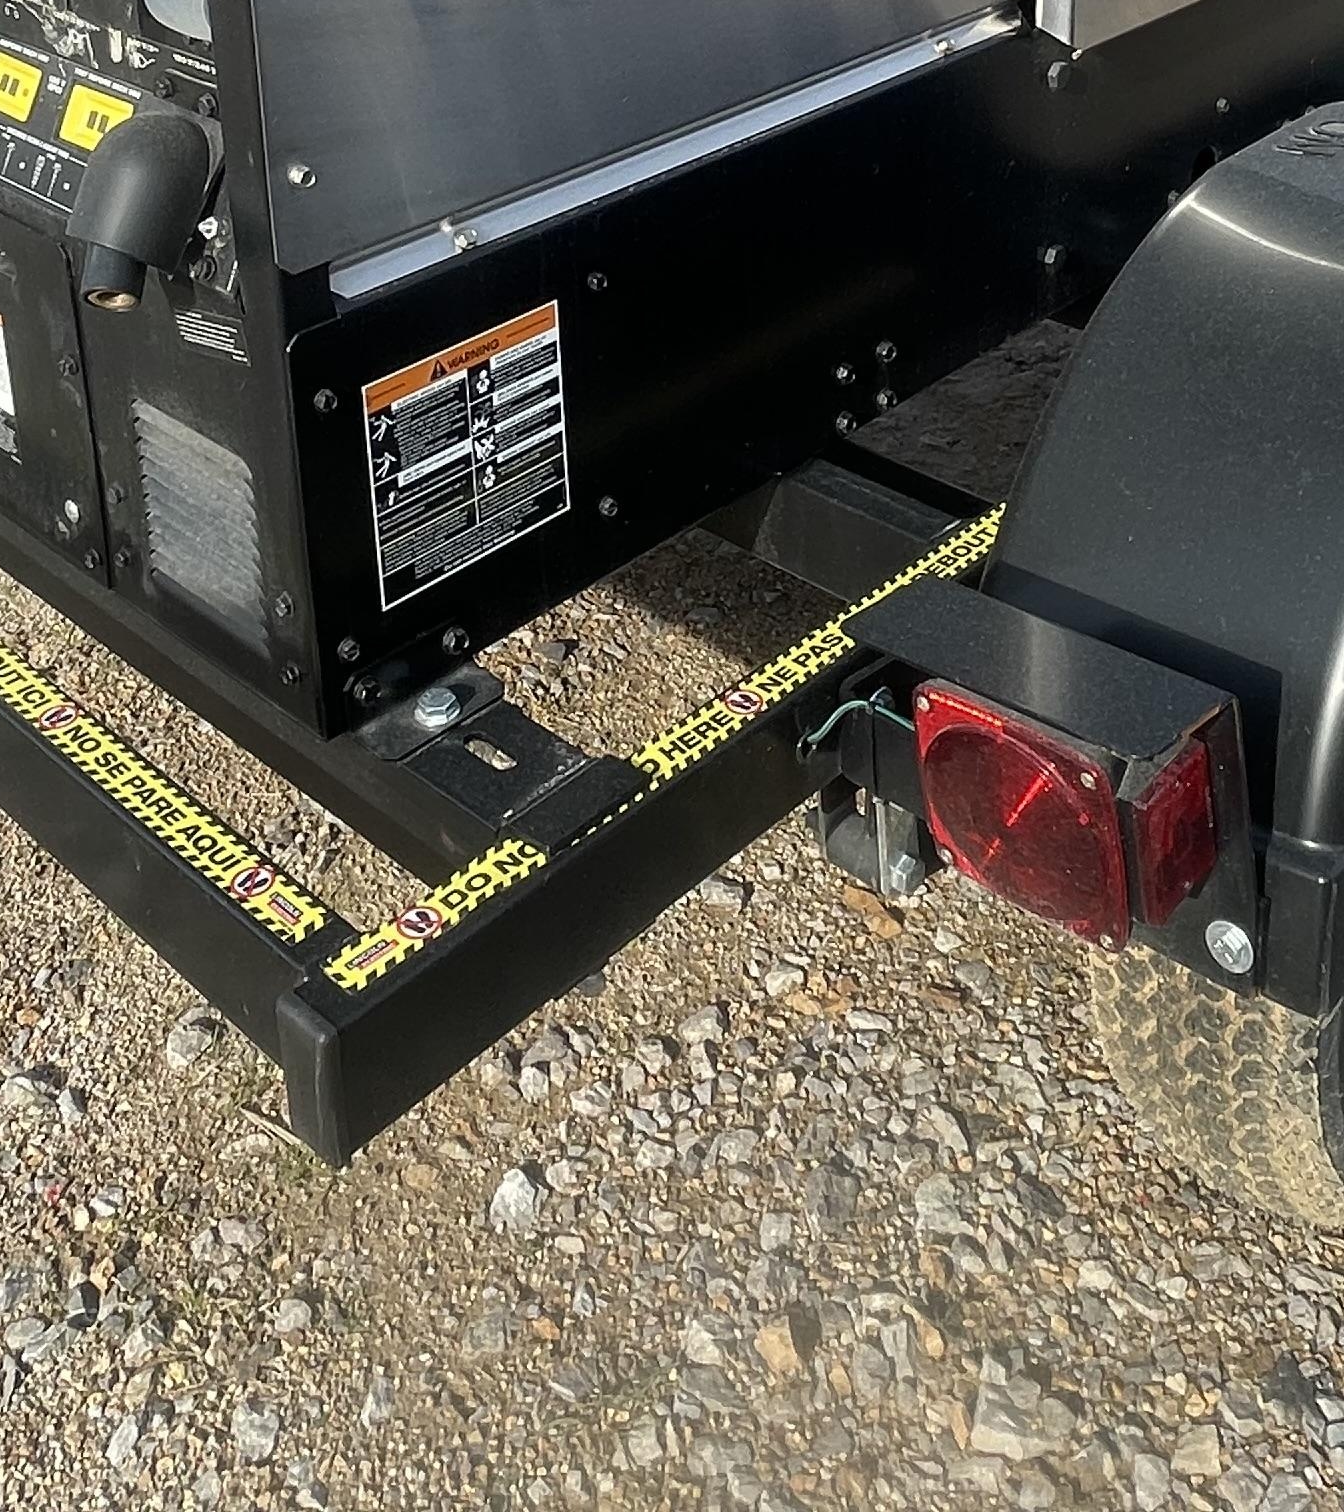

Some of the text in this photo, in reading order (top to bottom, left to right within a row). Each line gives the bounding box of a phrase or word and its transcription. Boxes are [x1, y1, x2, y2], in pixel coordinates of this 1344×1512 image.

[447, 338, 500, 369] WARNING
[755, 666, 796, 696] NE
[791, 631, 846, 668] PAS
[15, 680, 52, 709] ICI
[659, 709, 734, 756] HERE
[62, 723, 102, 755] NO
[94, 747, 132, 779] SE
[121, 775, 188, 827] PARE
[439, 842, 541, 910] DO NO
